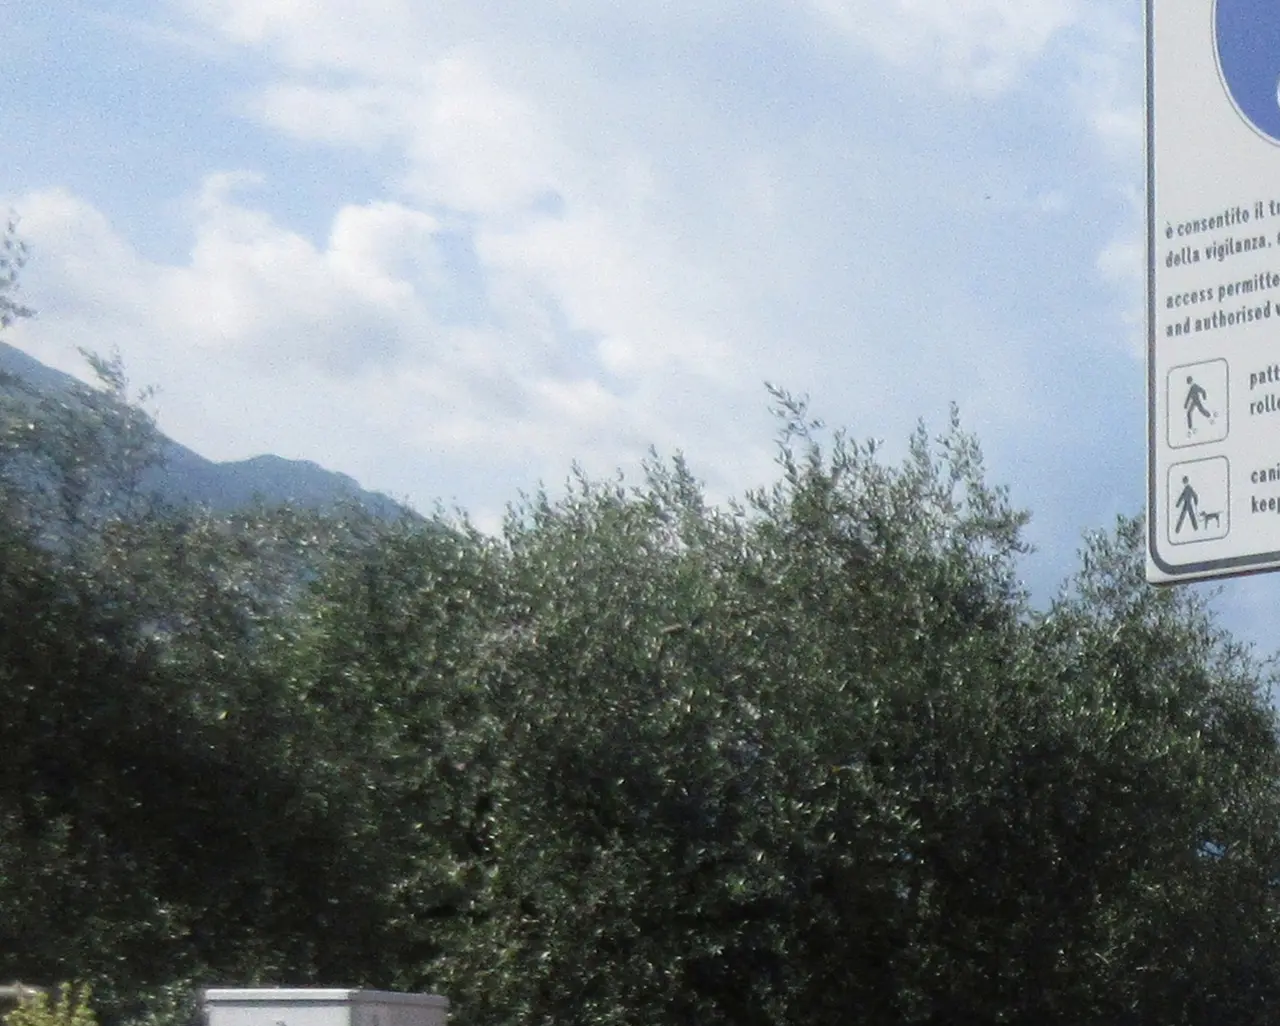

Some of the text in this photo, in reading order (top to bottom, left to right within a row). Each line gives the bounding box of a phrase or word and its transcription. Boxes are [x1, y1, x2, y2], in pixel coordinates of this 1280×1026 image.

[1165, 222, 1174, 239] è
[1177, 206, 1250, 237] consentito
[1254, 201, 1264, 220] il
[1165, 246, 1200, 268] della
[1166, 287, 1214, 309] access
[1166, 317, 1190, 337] and
[1195, 301, 1271, 332] authorised
[1251, 463, 1280, 484] cani
